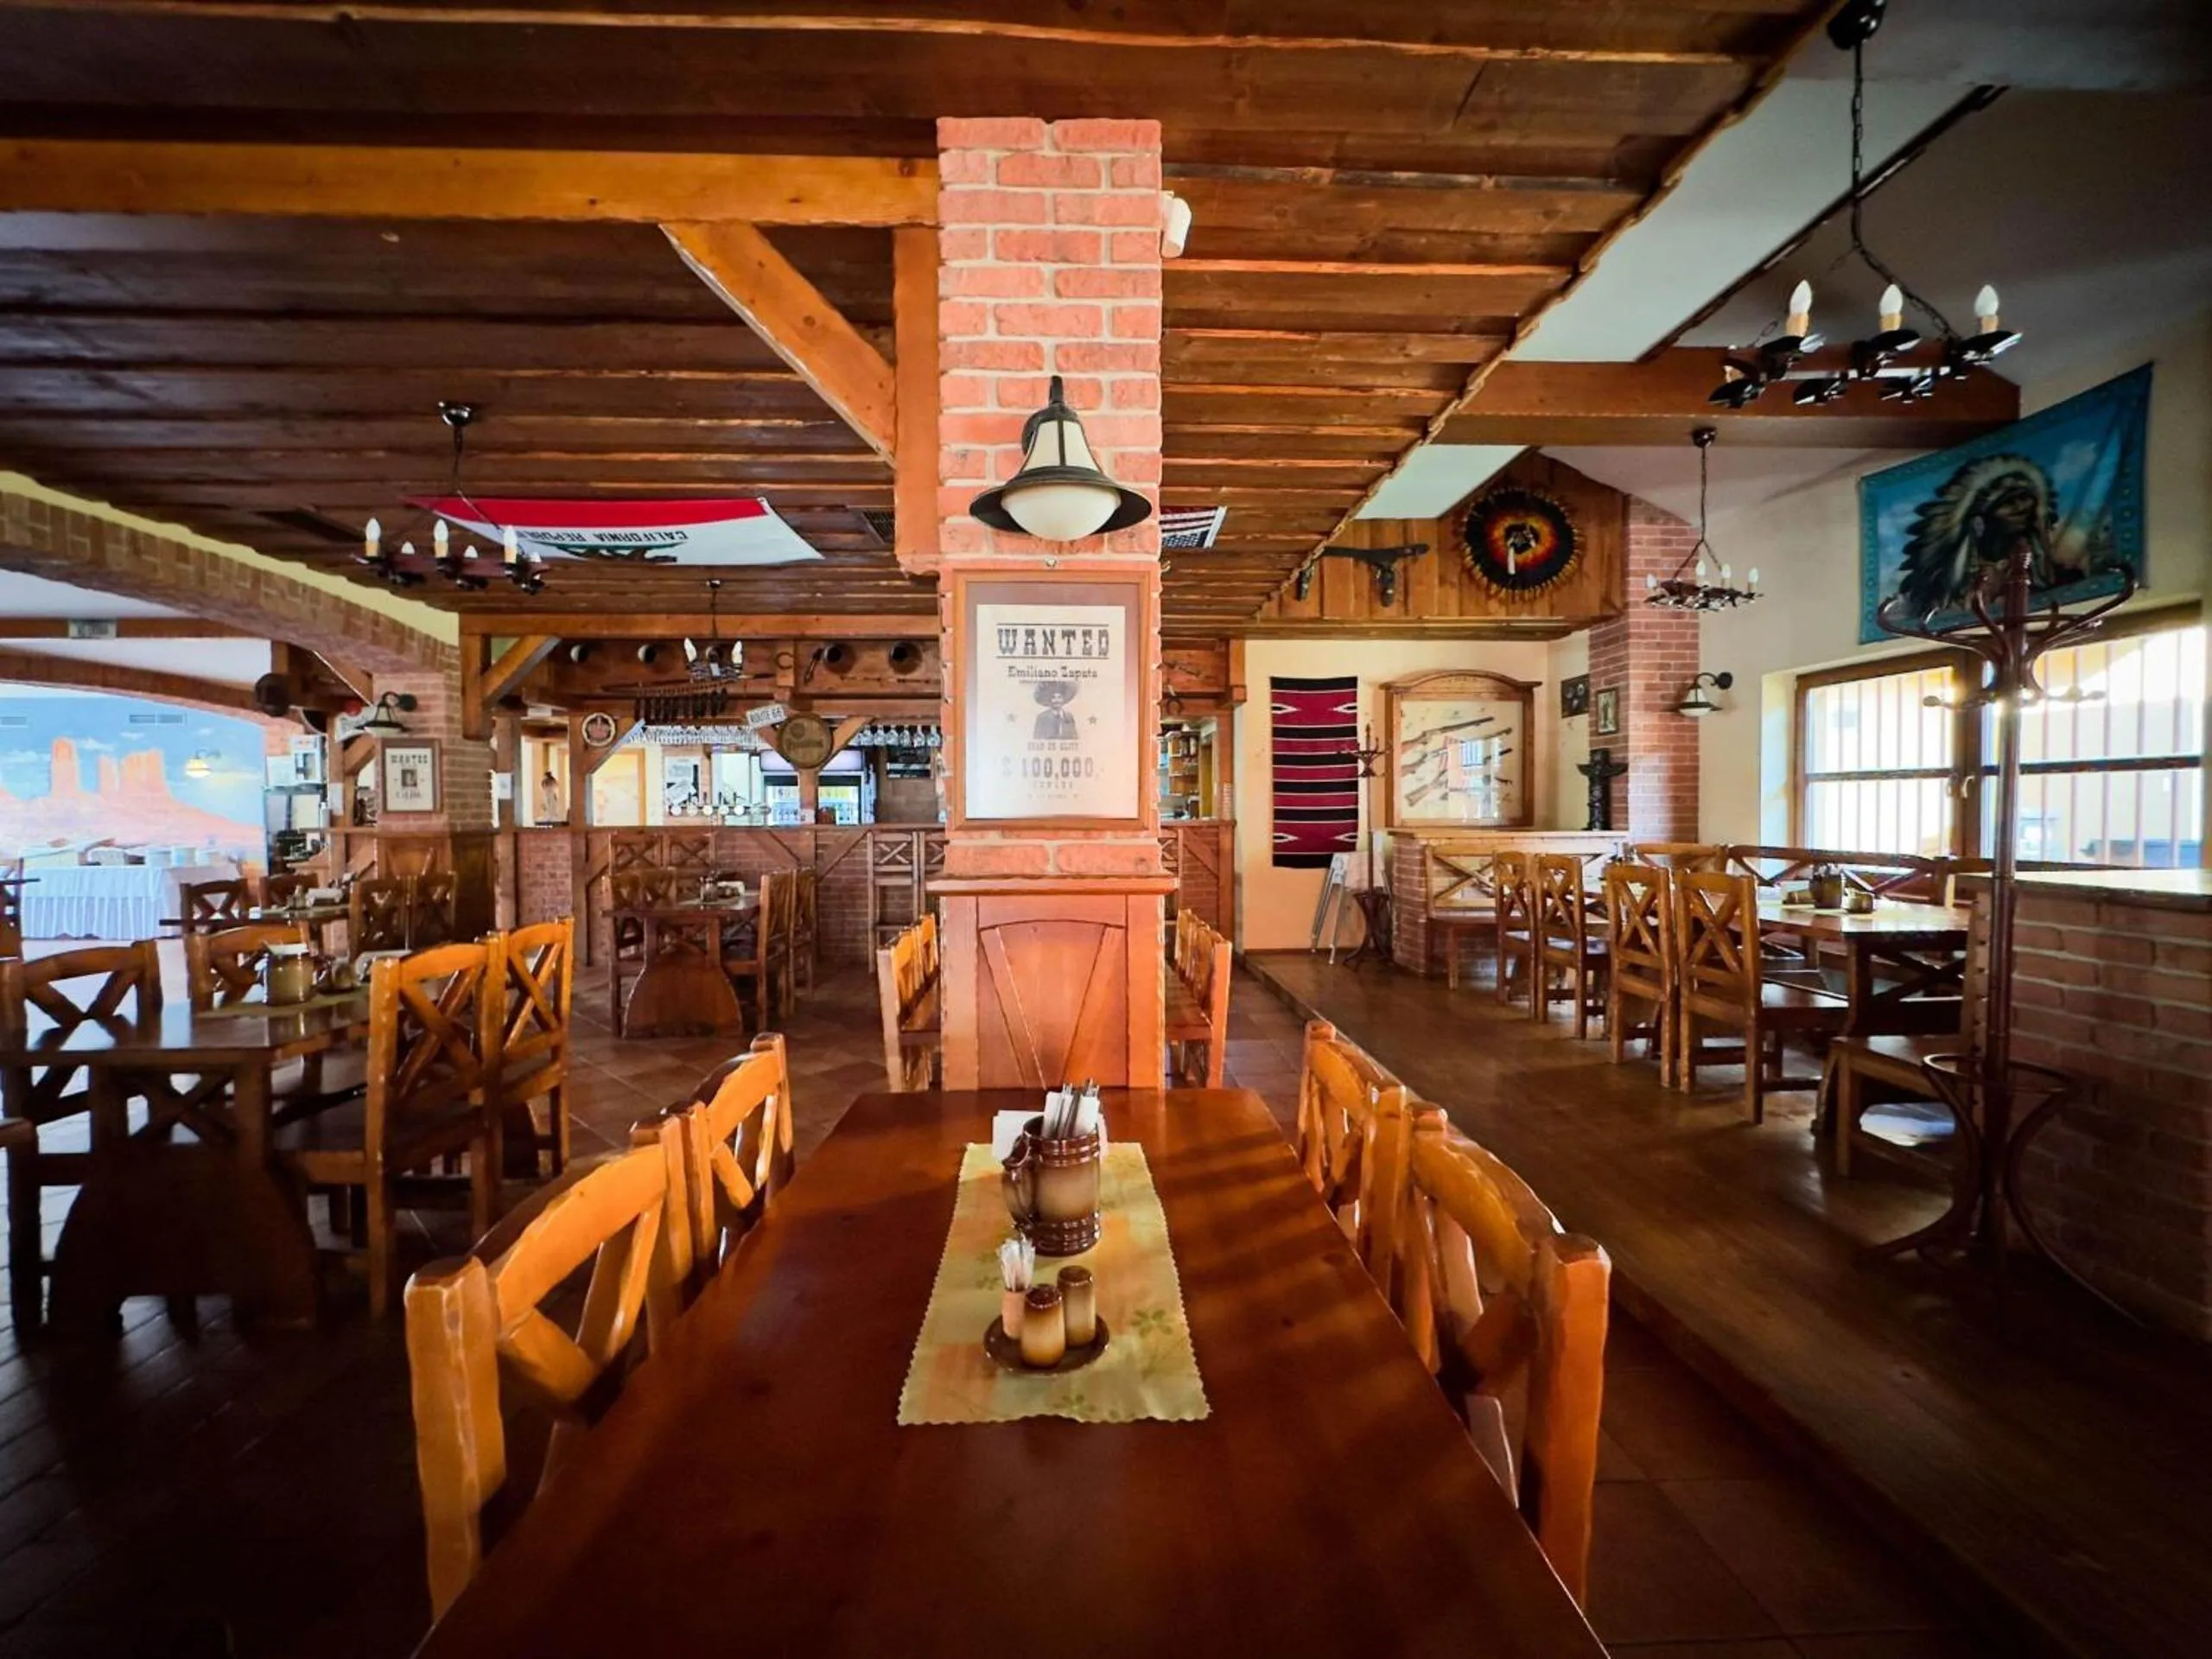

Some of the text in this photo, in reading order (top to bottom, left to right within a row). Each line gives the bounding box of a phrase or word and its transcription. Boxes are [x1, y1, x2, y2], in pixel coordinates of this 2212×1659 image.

[593, 531, 689, 543] CALIFORNIA
[997, 628, 1109, 657] WANTED
[1007, 665, 1098, 681] Emiliano Zapata
